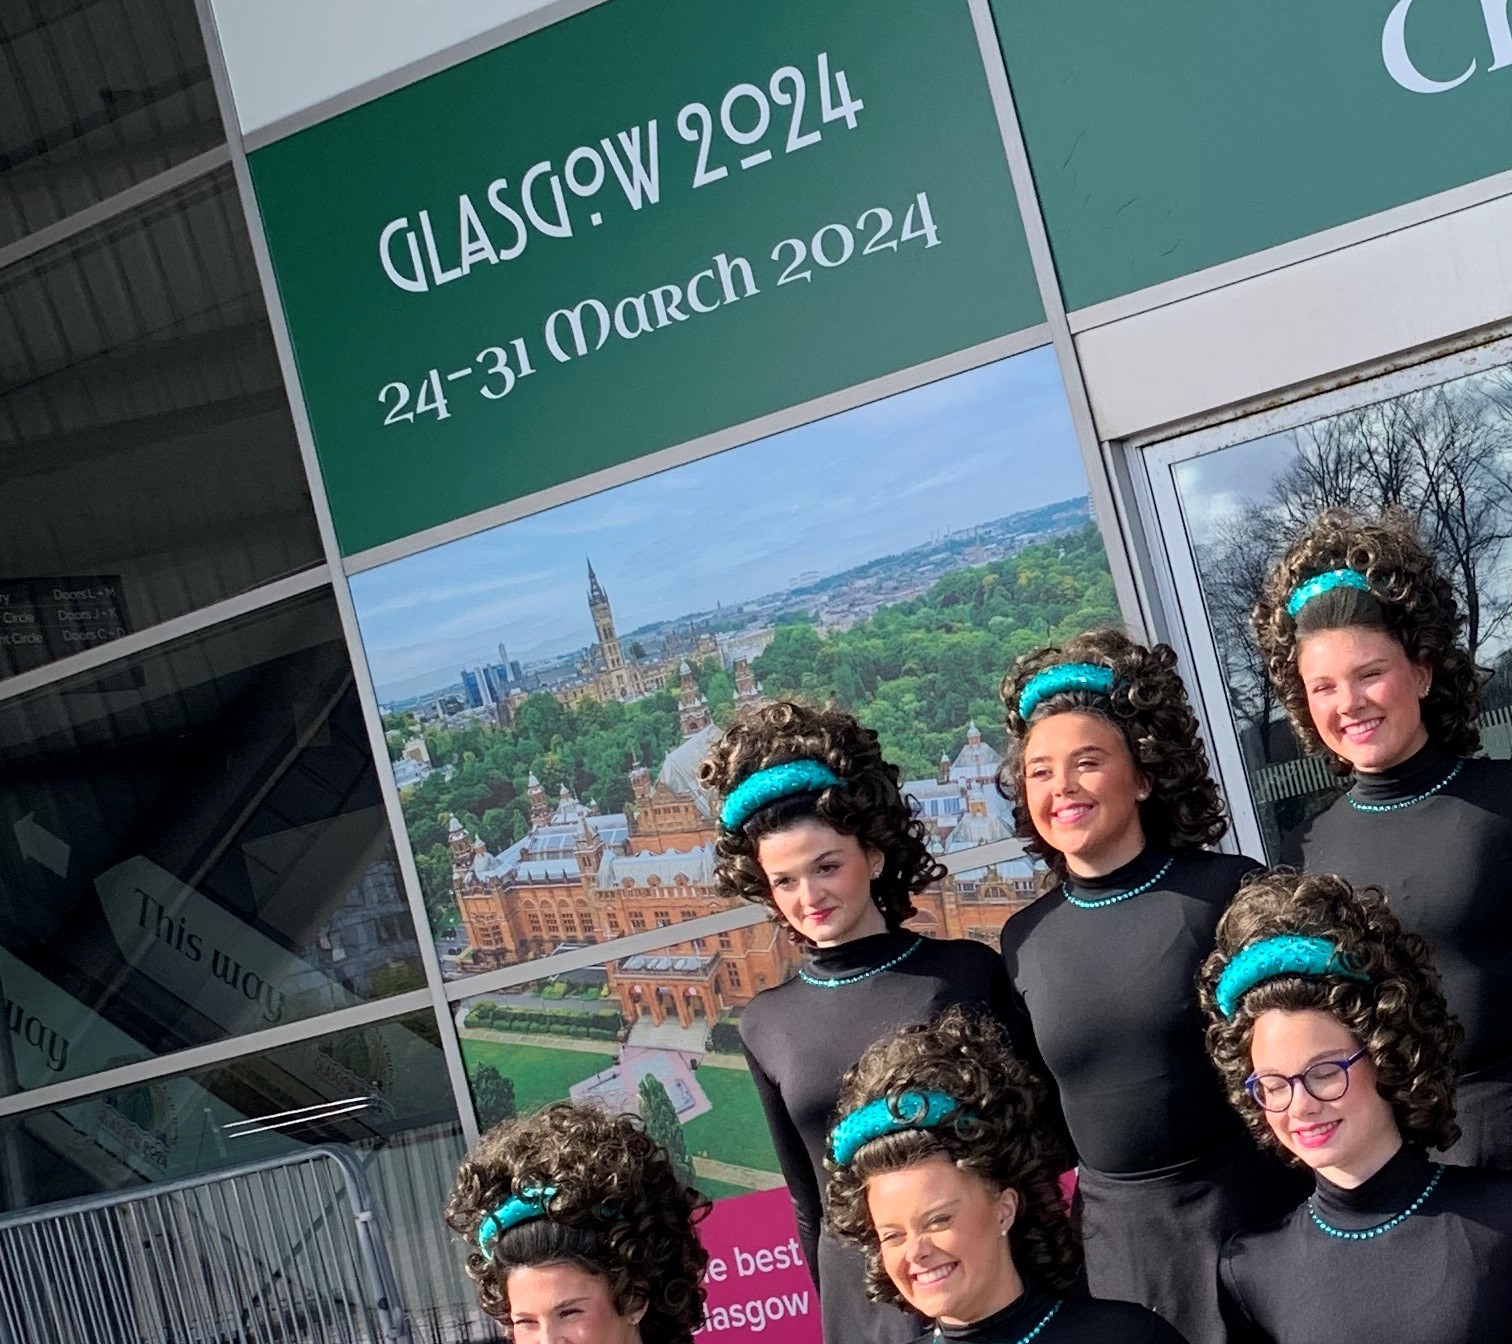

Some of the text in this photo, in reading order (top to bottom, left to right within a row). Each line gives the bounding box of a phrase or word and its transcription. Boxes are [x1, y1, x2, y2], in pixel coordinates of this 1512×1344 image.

[379, 52, 864, 292] GLASGOW 2024
[378, 192, 941, 426] 24-31 March 2024
[53, 589, 87, 600] Doors
[58, 609, 92, 621] Doors
[63, 630, 97, 641] Doors
[134, 888, 286, 1022] This way
[733, 1238, 803, 1277] best
[691, 1290, 809, 1335] lasgow
